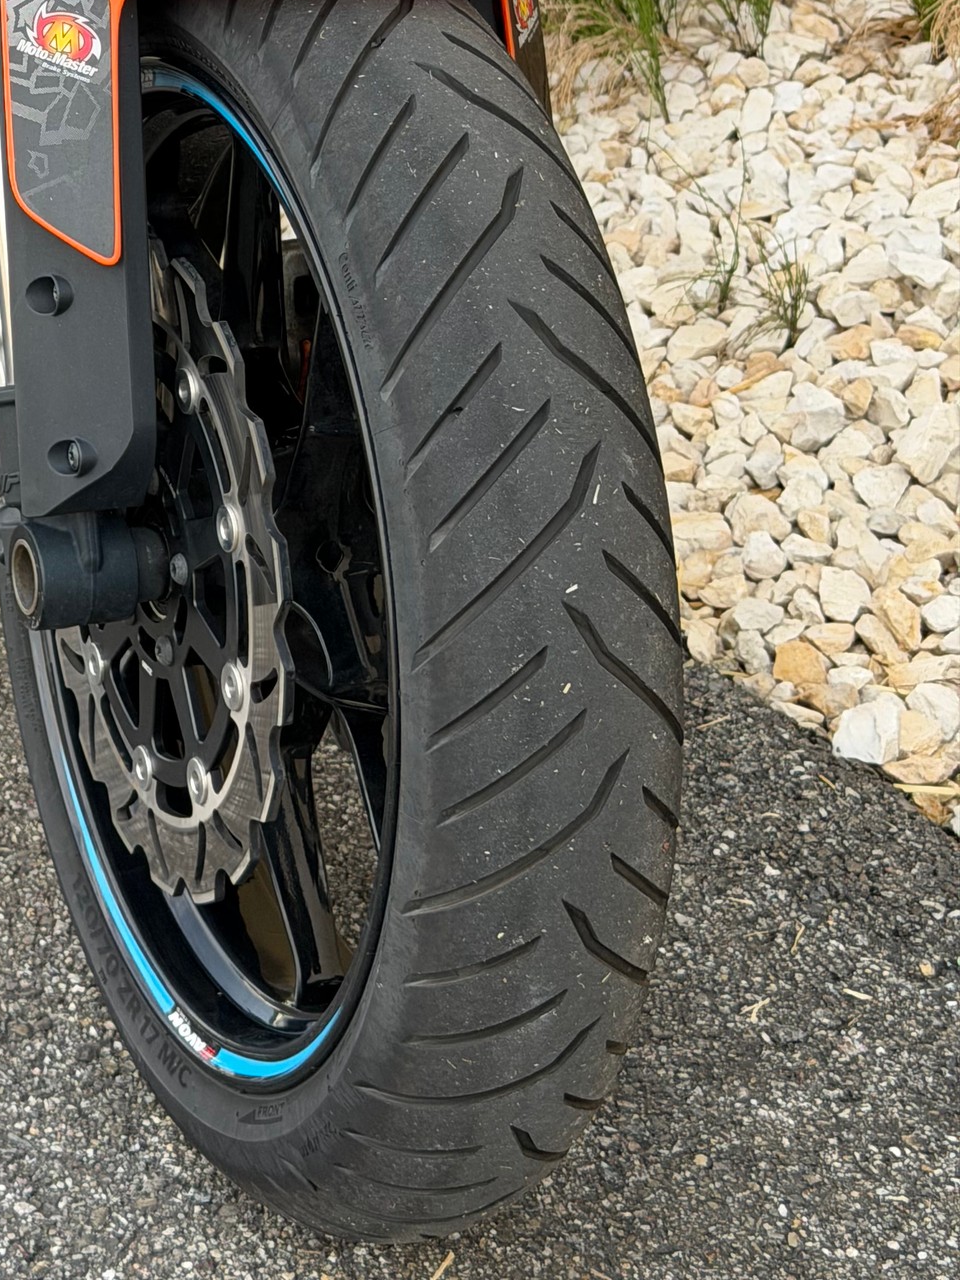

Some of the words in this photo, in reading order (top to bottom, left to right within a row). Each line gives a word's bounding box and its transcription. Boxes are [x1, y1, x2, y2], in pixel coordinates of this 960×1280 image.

[41, 61, 62, 73] Brake
[62, 67, 91, 84] Systems
[168, 1011, 207, 1052] AVON
[257, 1102, 286, 1117] FRONT
